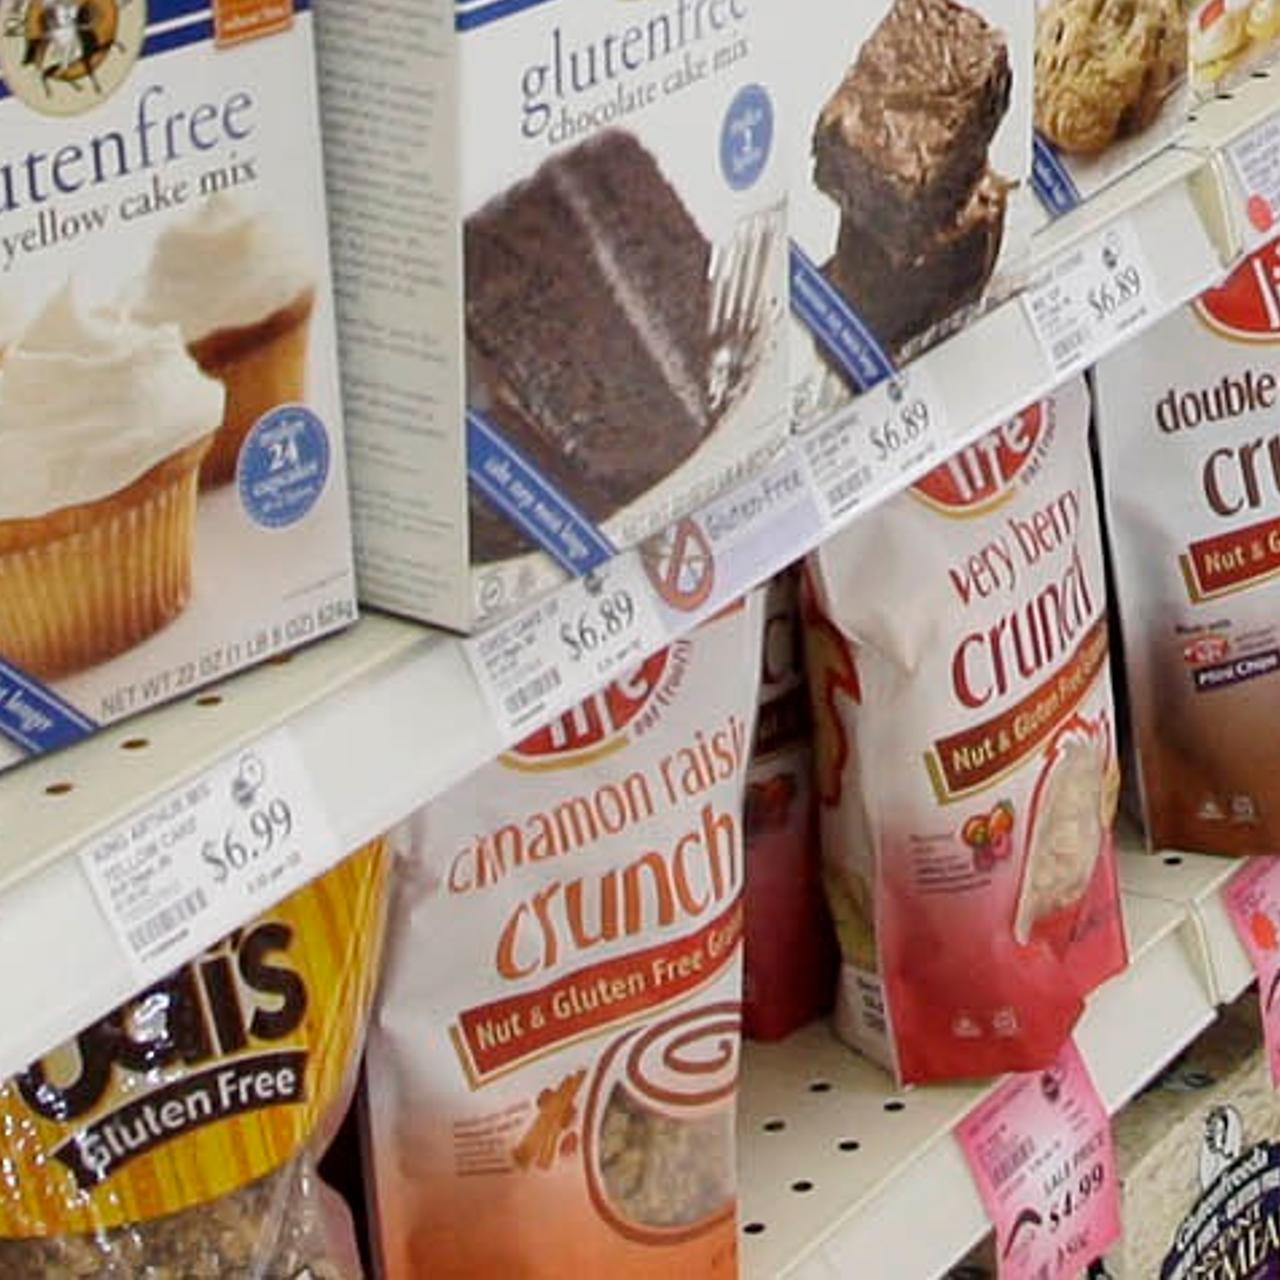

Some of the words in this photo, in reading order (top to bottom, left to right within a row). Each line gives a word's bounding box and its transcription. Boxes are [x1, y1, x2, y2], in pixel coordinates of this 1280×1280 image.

[547, 82, 658, 147] chocolate
[661, 53, 709, 95] cake
[714, 36, 750, 76] mix
[0, 203, 109, 270] yellow
[119, 177, 189, 222] cake
[199, 150, 261, 197] mix
[868, 402, 930, 463] $6.89
[1155, 370, 1277, 435] double
[948, 552, 1015, 606] very
[1204, 541, 1246, 573] Nut
[559, 594, 637, 666] $6.89
[1236, 650, 1280, 676] Chips
[100, 691, 138, 717] NET
[952, 745, 994, 774] Nut
[198, 798, 296, 885] $6.99
[447, 767, 656, 896] cinnamon
[495, 808, 740, 982] crunch
[476, 1006, 525, 1050] Nut
[529, 1004, 546, 1027] &
[552, 966, 648, 1025] Gluten
[651, 946, 703, 981] Free
[75, 1082, 216, 1172] Gluten
[218, 1065, 298, 1106] Free
[1048, 1163, 1106, 1229] $4.99
